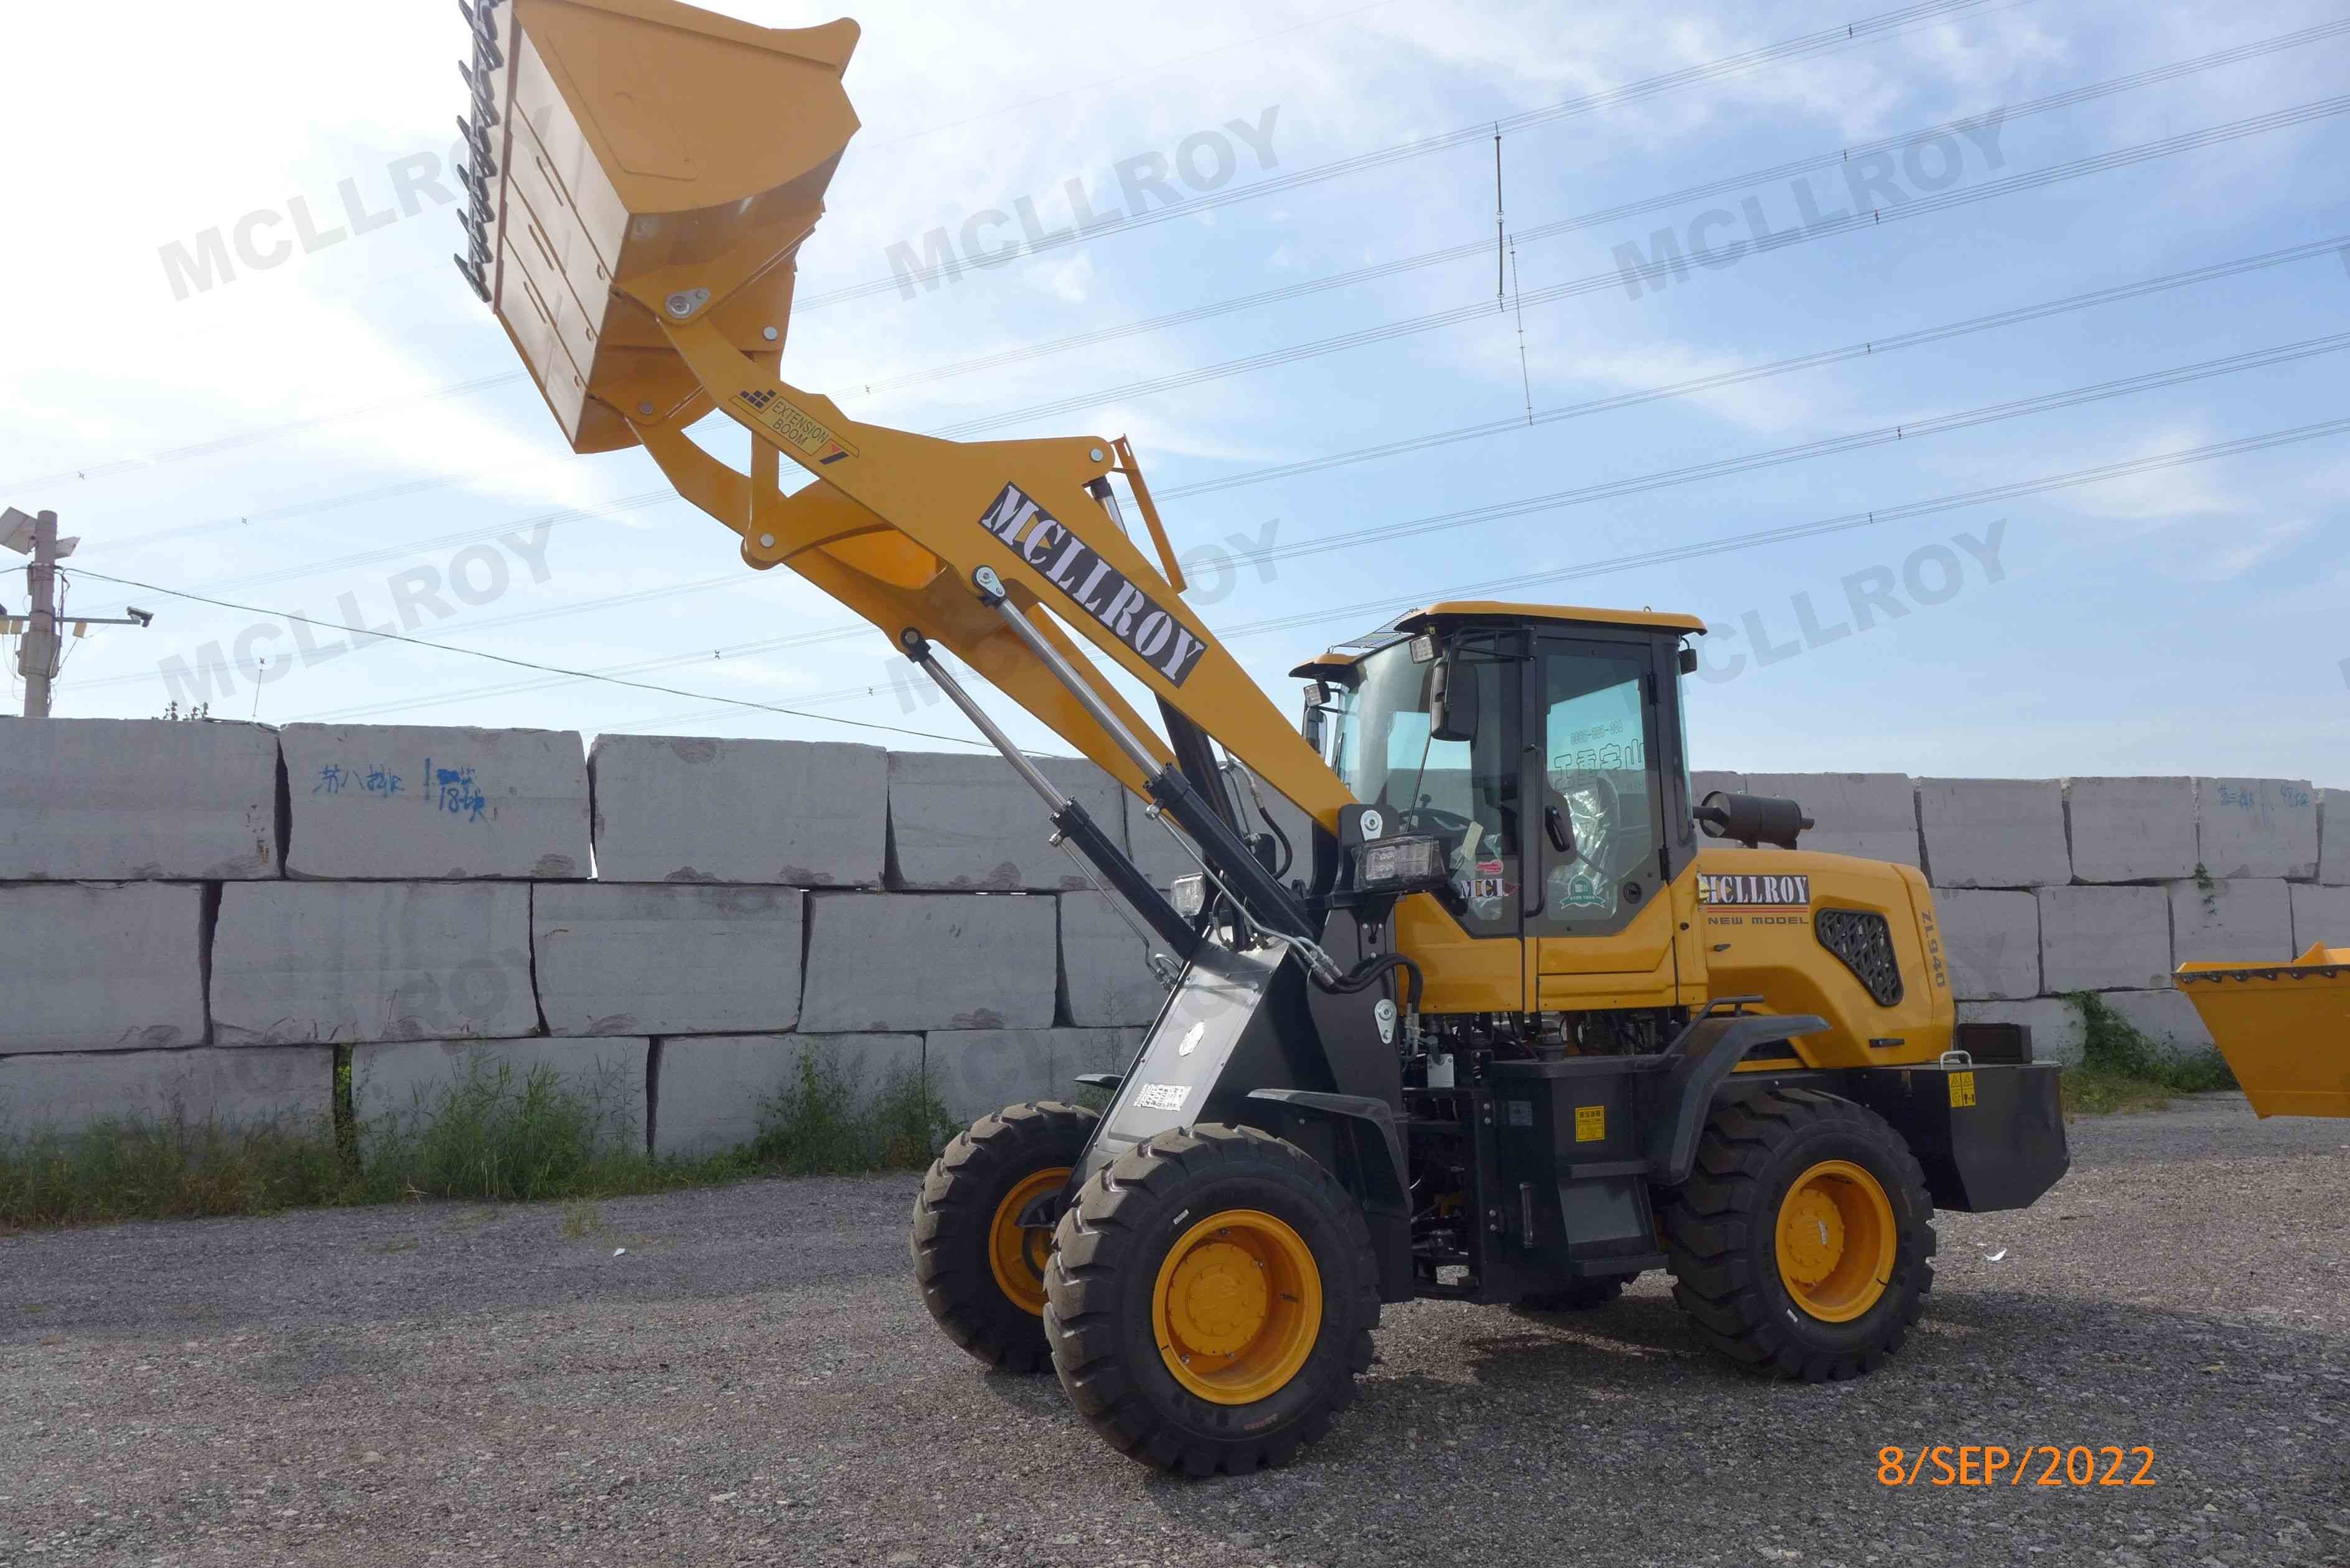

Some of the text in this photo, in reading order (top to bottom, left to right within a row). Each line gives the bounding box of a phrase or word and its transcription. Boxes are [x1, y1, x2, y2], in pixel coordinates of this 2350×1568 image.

[772, 402, 829, 444] EXTENSION
[772, 419, 808, 446] BOOM
[981, 485, 1204, 680] MCLLROY
[1708, 917, 1809, 925] NEW MODEL
[1922, 910, 1945, 987] ZL940
